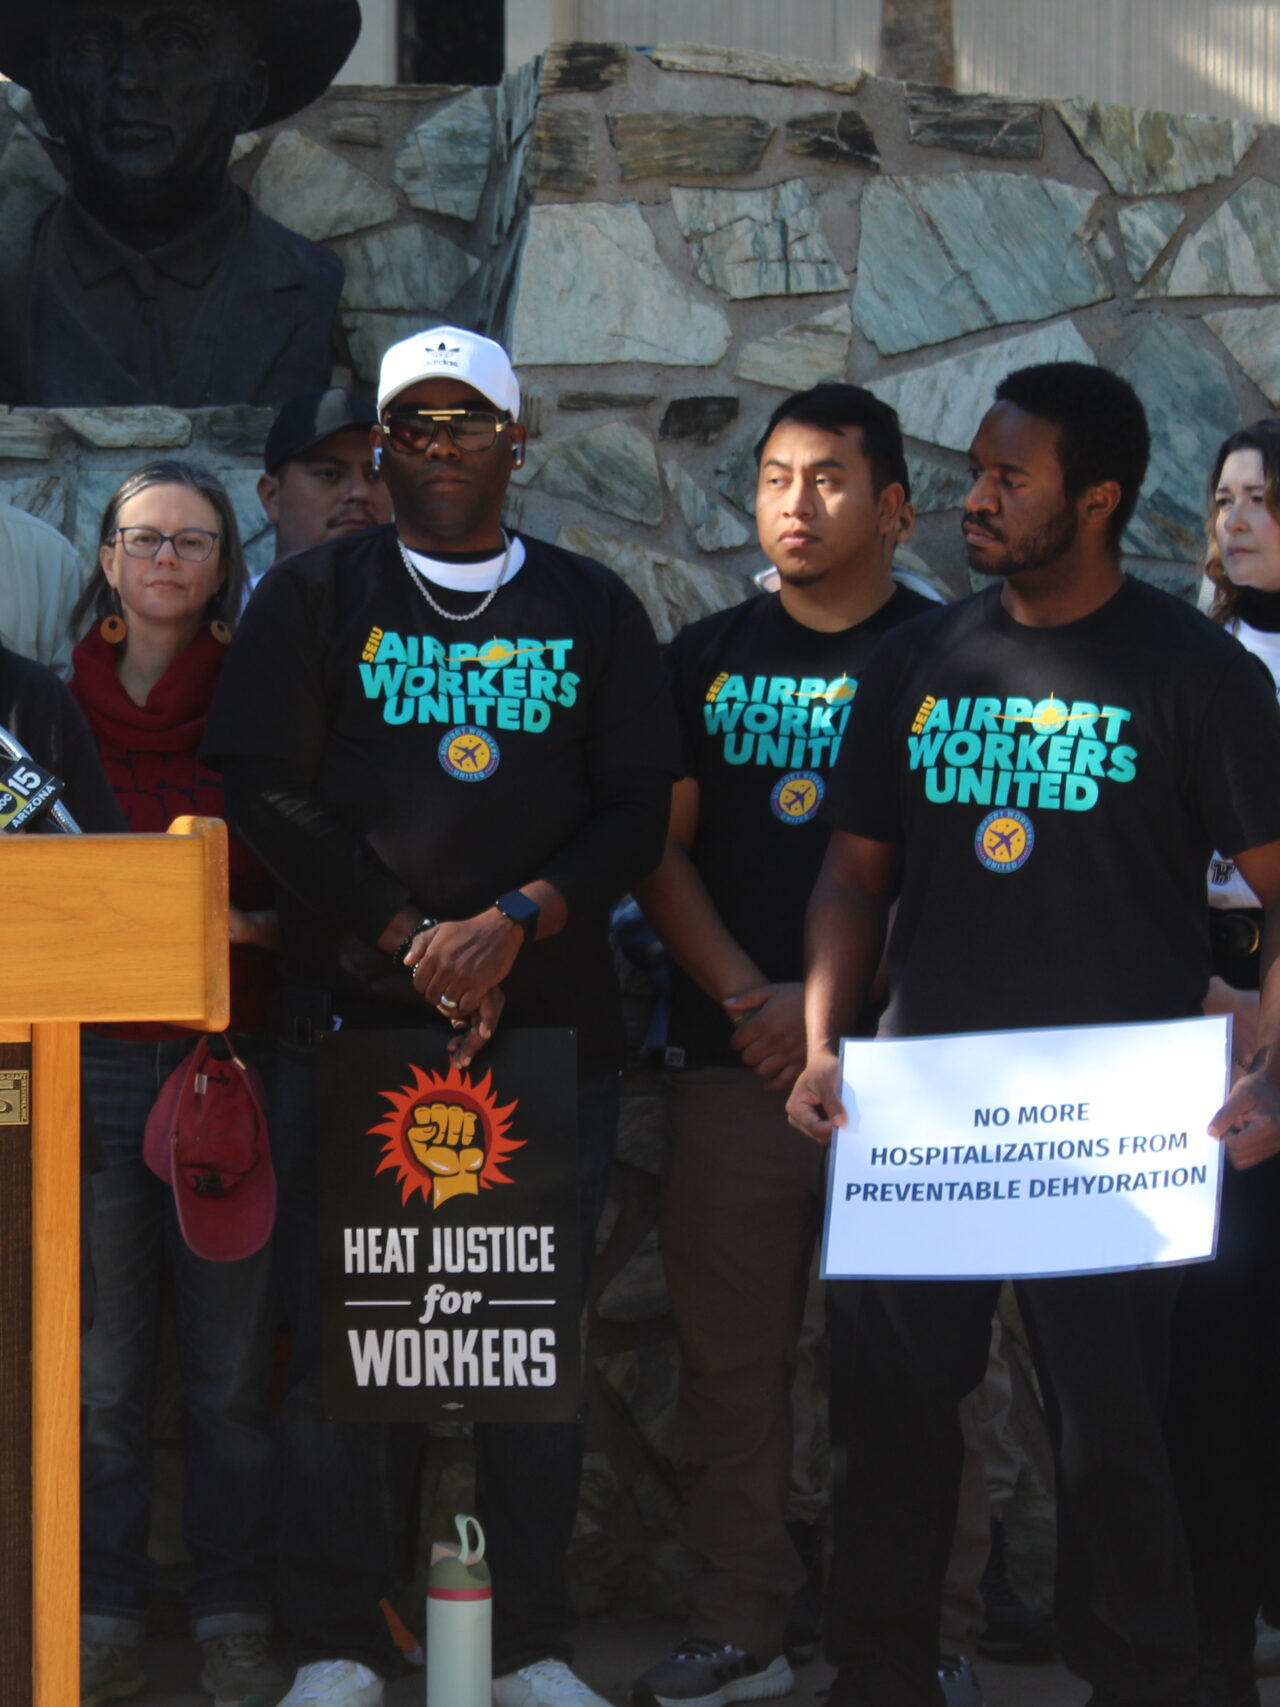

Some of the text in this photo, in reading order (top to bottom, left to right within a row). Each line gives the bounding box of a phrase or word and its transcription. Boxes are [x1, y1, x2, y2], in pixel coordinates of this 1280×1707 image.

[362, 626, 384, 664] SEIU
[374, 631, 574, 670] AIRPORT
[358, 663, 581, 708] WORKERS
[705, 671, 730, 703] SEIU
[382, 694, 551, 734] UNITED
[911, 695, 936, 735] SEIU
[921, 696, 1132, 743] AIRPORT
[908, 730, 1138, 784] WORKERS
[7, 766, 41, 797] 15
[925, 766, 1099, 812] UNITED
[11, 784, 57, 829] ARIZONA
[973, 1102, 1090, 1128] NO MORE
[870, 1131, 1188, 1166] HOSPITALIZATIONS FROM
[845, 1164, 1207, 1202] PREVENTABLE DEHYDRATION
[344, 1225, 555, 1274] HEAT JUSTICE
[419, 1283, 482, 1324] for
[347, 1328, 557, 1387] WORKERS
